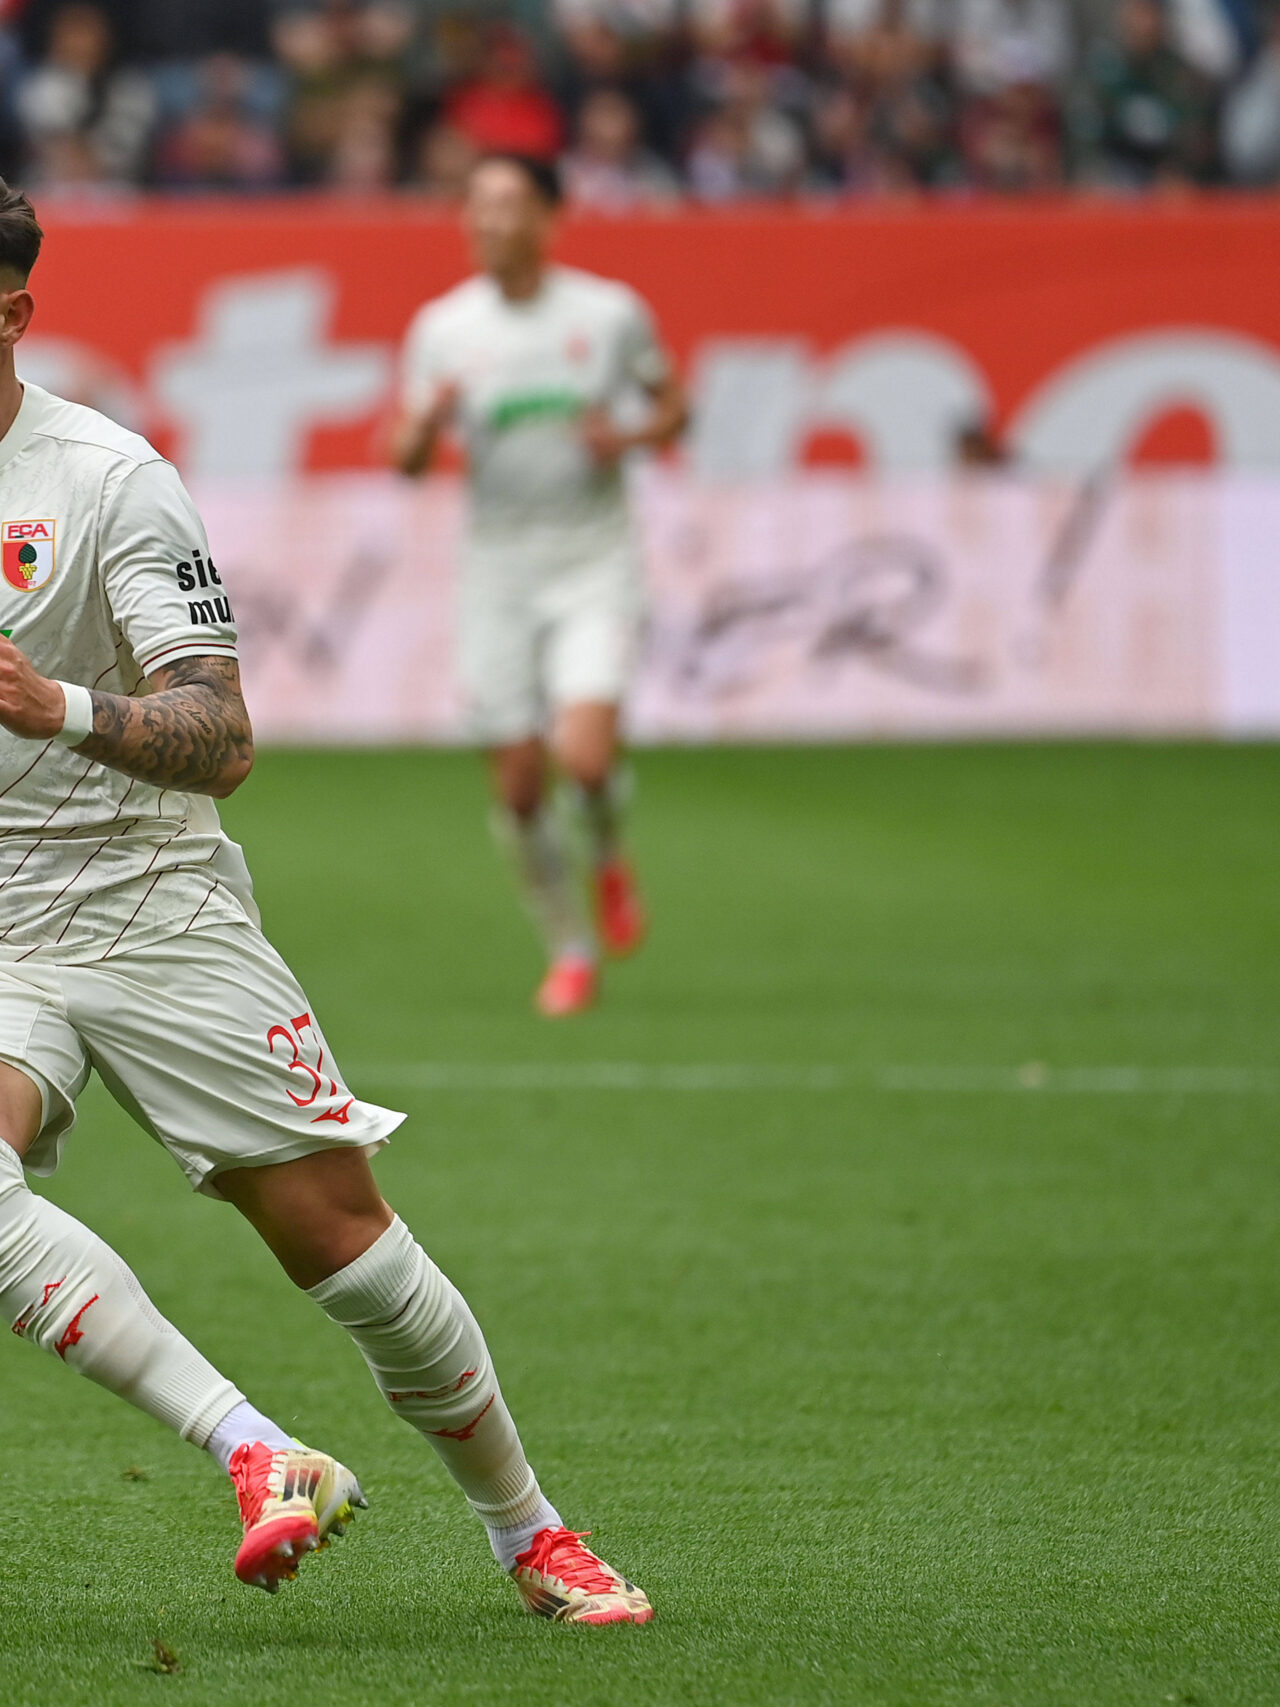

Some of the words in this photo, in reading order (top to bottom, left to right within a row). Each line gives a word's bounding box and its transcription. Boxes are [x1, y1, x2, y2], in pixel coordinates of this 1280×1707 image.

[7, 523, 49, 540] FCA
[187, 596, 235, 625] mu
[267, 1012, 337, 1107] 37
